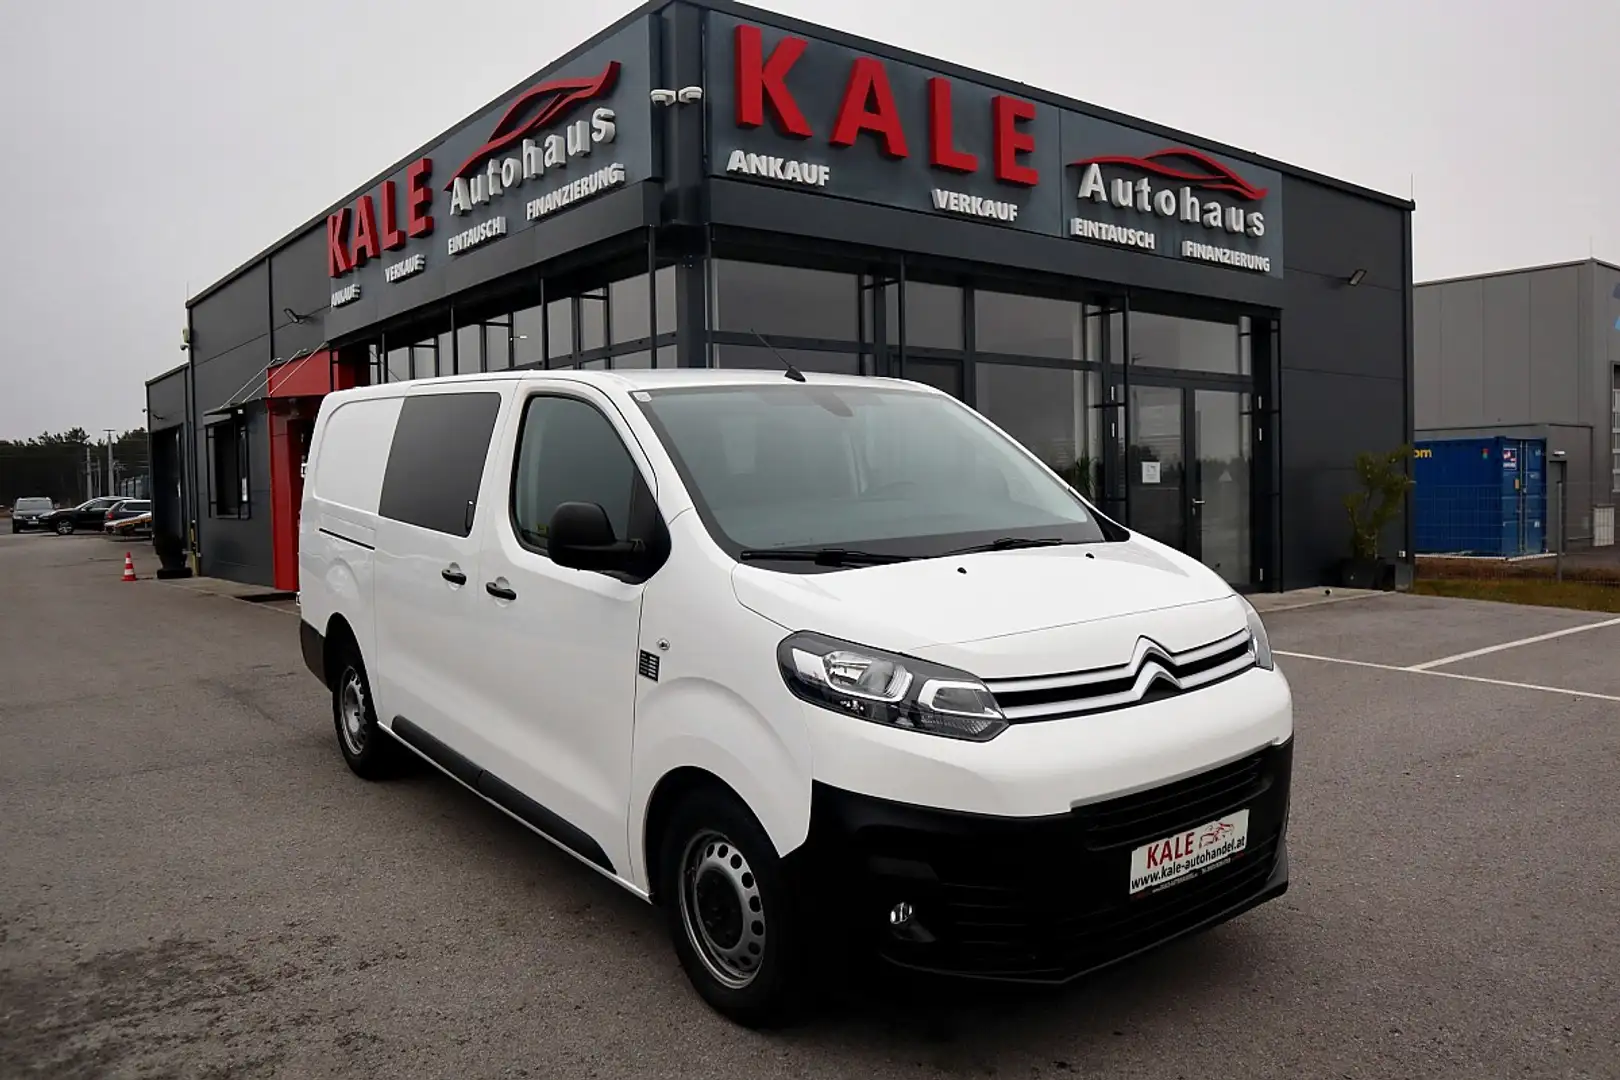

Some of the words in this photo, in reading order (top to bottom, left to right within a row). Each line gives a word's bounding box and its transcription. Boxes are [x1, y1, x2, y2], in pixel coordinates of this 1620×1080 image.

[735, 24, 1038, 187] KALE
[1077, 163, 1265, 237] Autohaus
[326, 157, 433, 278] KALE
[450, 107, 616, 216] Autohaus
[384, 253, 425, 283] VERKAUF
[448, 216, 507, 255] EINTAUSCH
[526, 162, 625, 220] FINANZIERUNG
[727, 150, 830, 187] ANKAUF
[931, 188, 1018, 222] VERKAUF
[1070, 217, 1155, 249] EINTAUSCH
[1182, 240, 1270, 272] FINANZIERUNG
[1131, 836, 1245, 889] www.kale-autohandel.at
[1147, 832, 1195, 869] KALE
